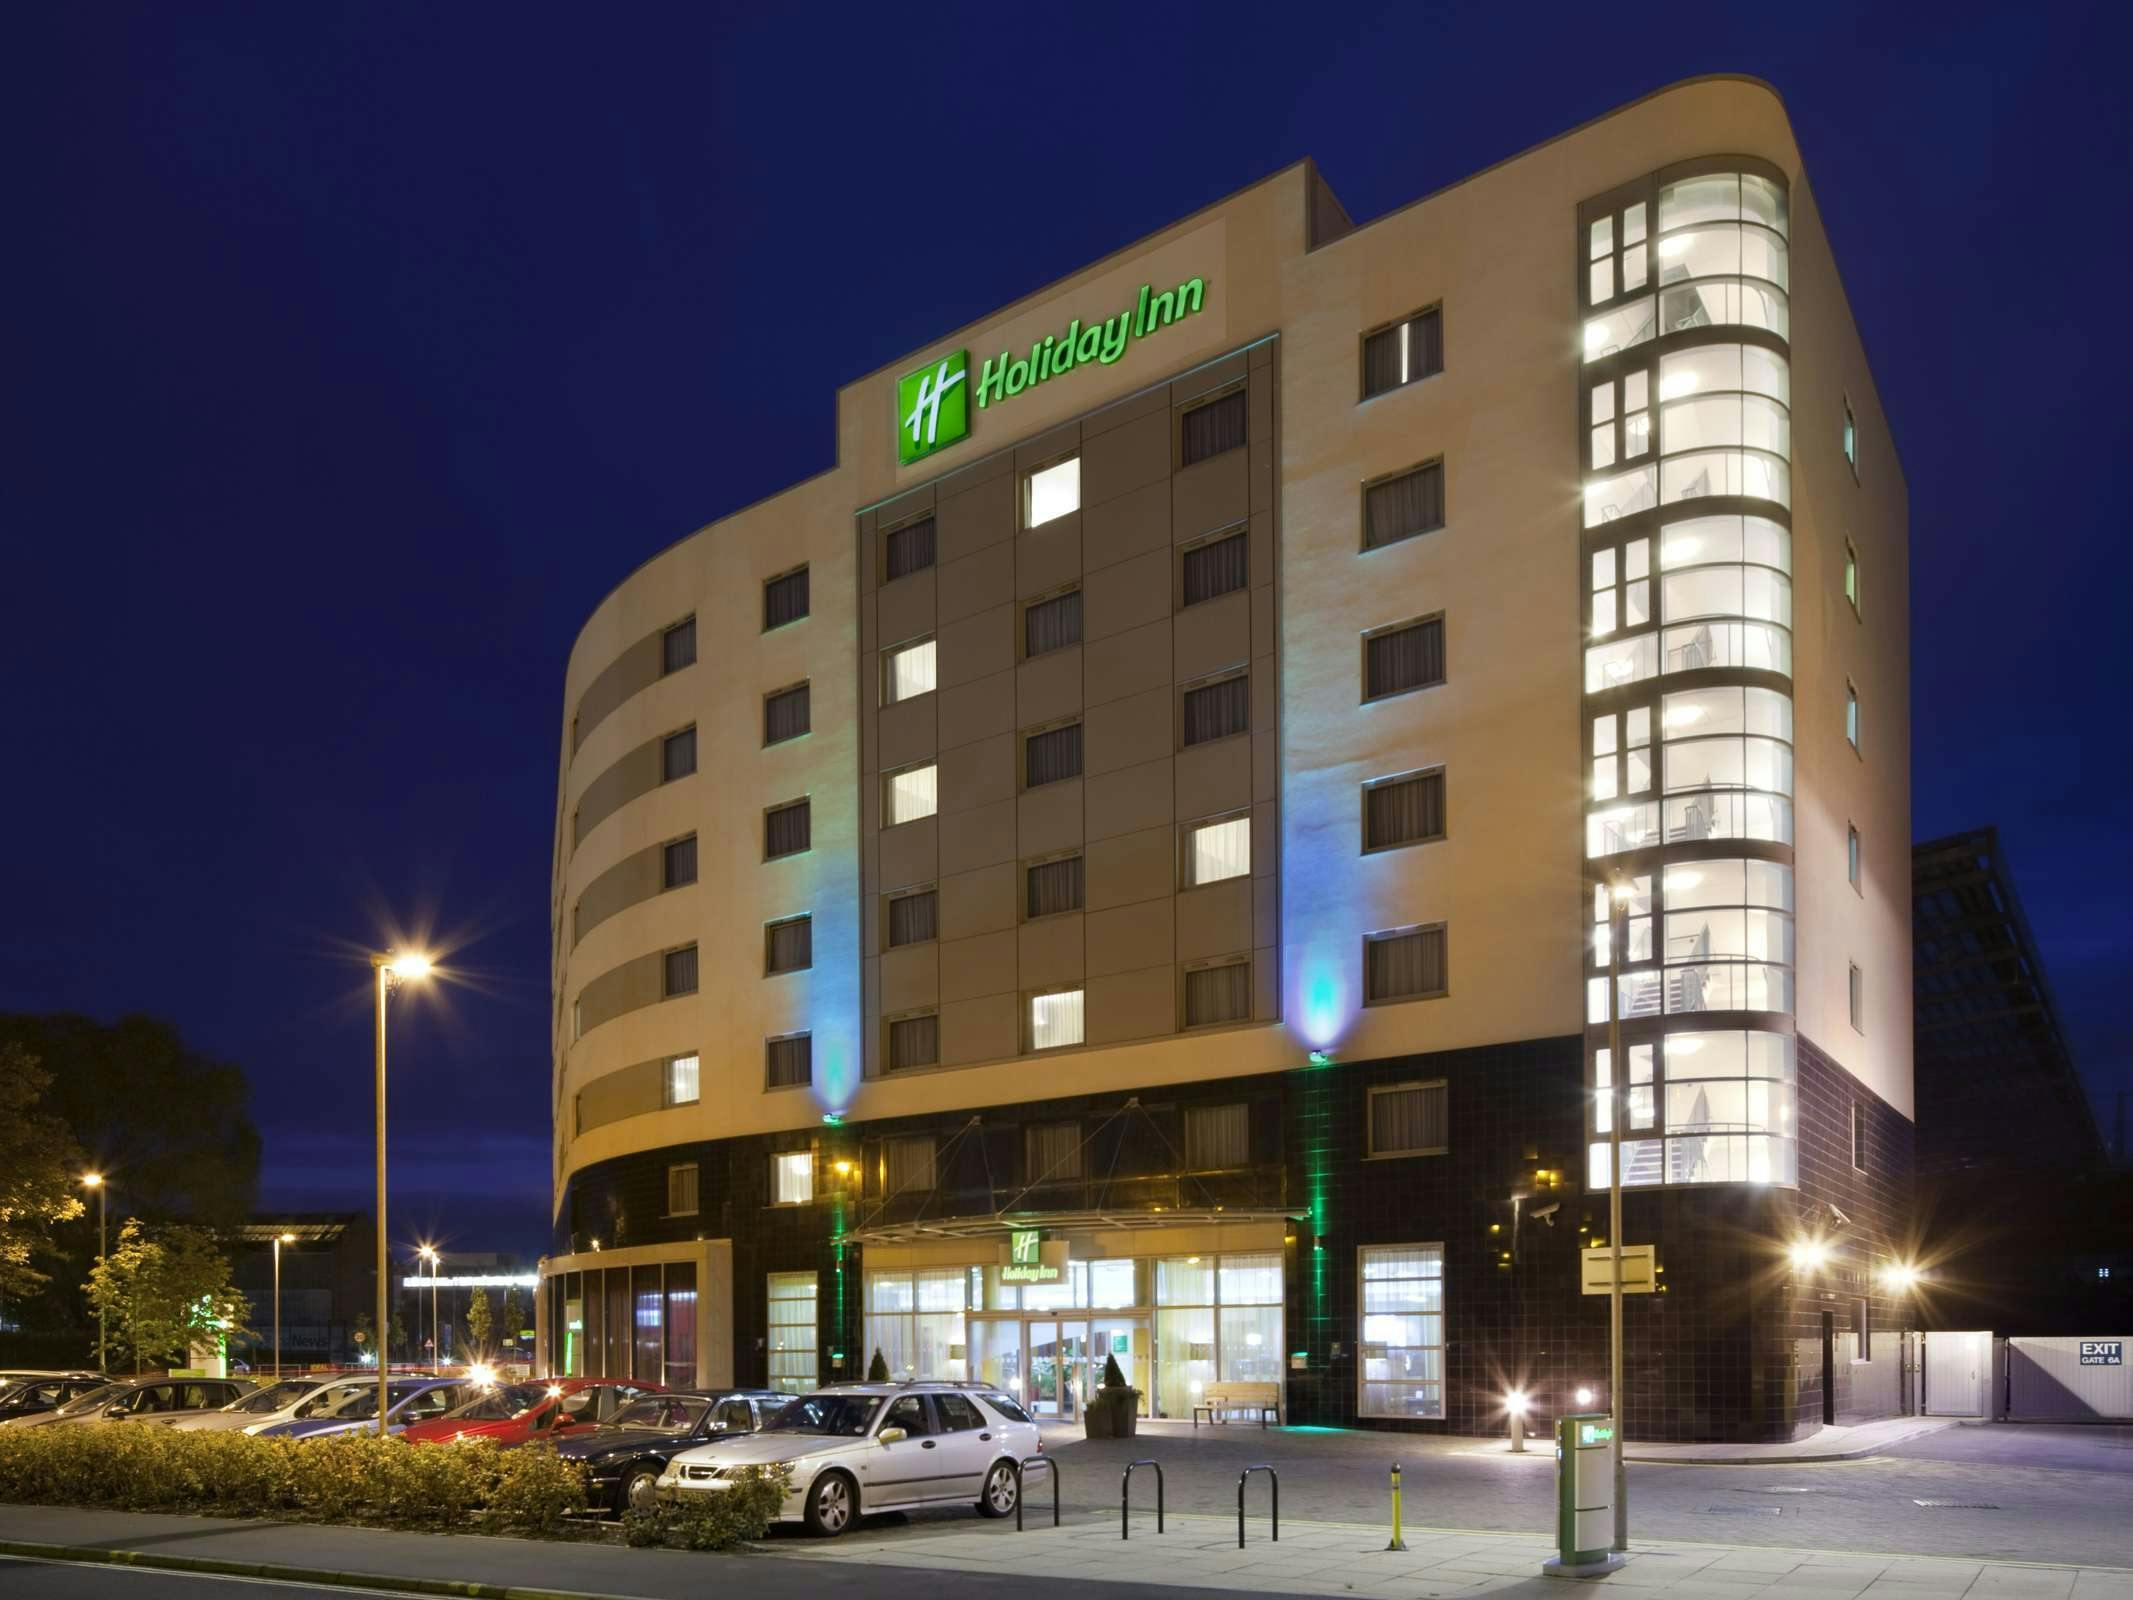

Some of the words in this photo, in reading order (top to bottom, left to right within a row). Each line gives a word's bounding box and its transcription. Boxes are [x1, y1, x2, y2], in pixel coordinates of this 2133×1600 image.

[975, 311, 1131, 409] Holiday
[1134, 277, 1205, 338] Inn
[1002, 1265, 1039, 1282] Holiday
[1040, 1265, 1058, 1279] Inn
[2082, 1343, 2119, 1355] EXIT
[2081, 1356, 2105, 1364] GATE
[2107, 1356, 2121, 1364] 6A
